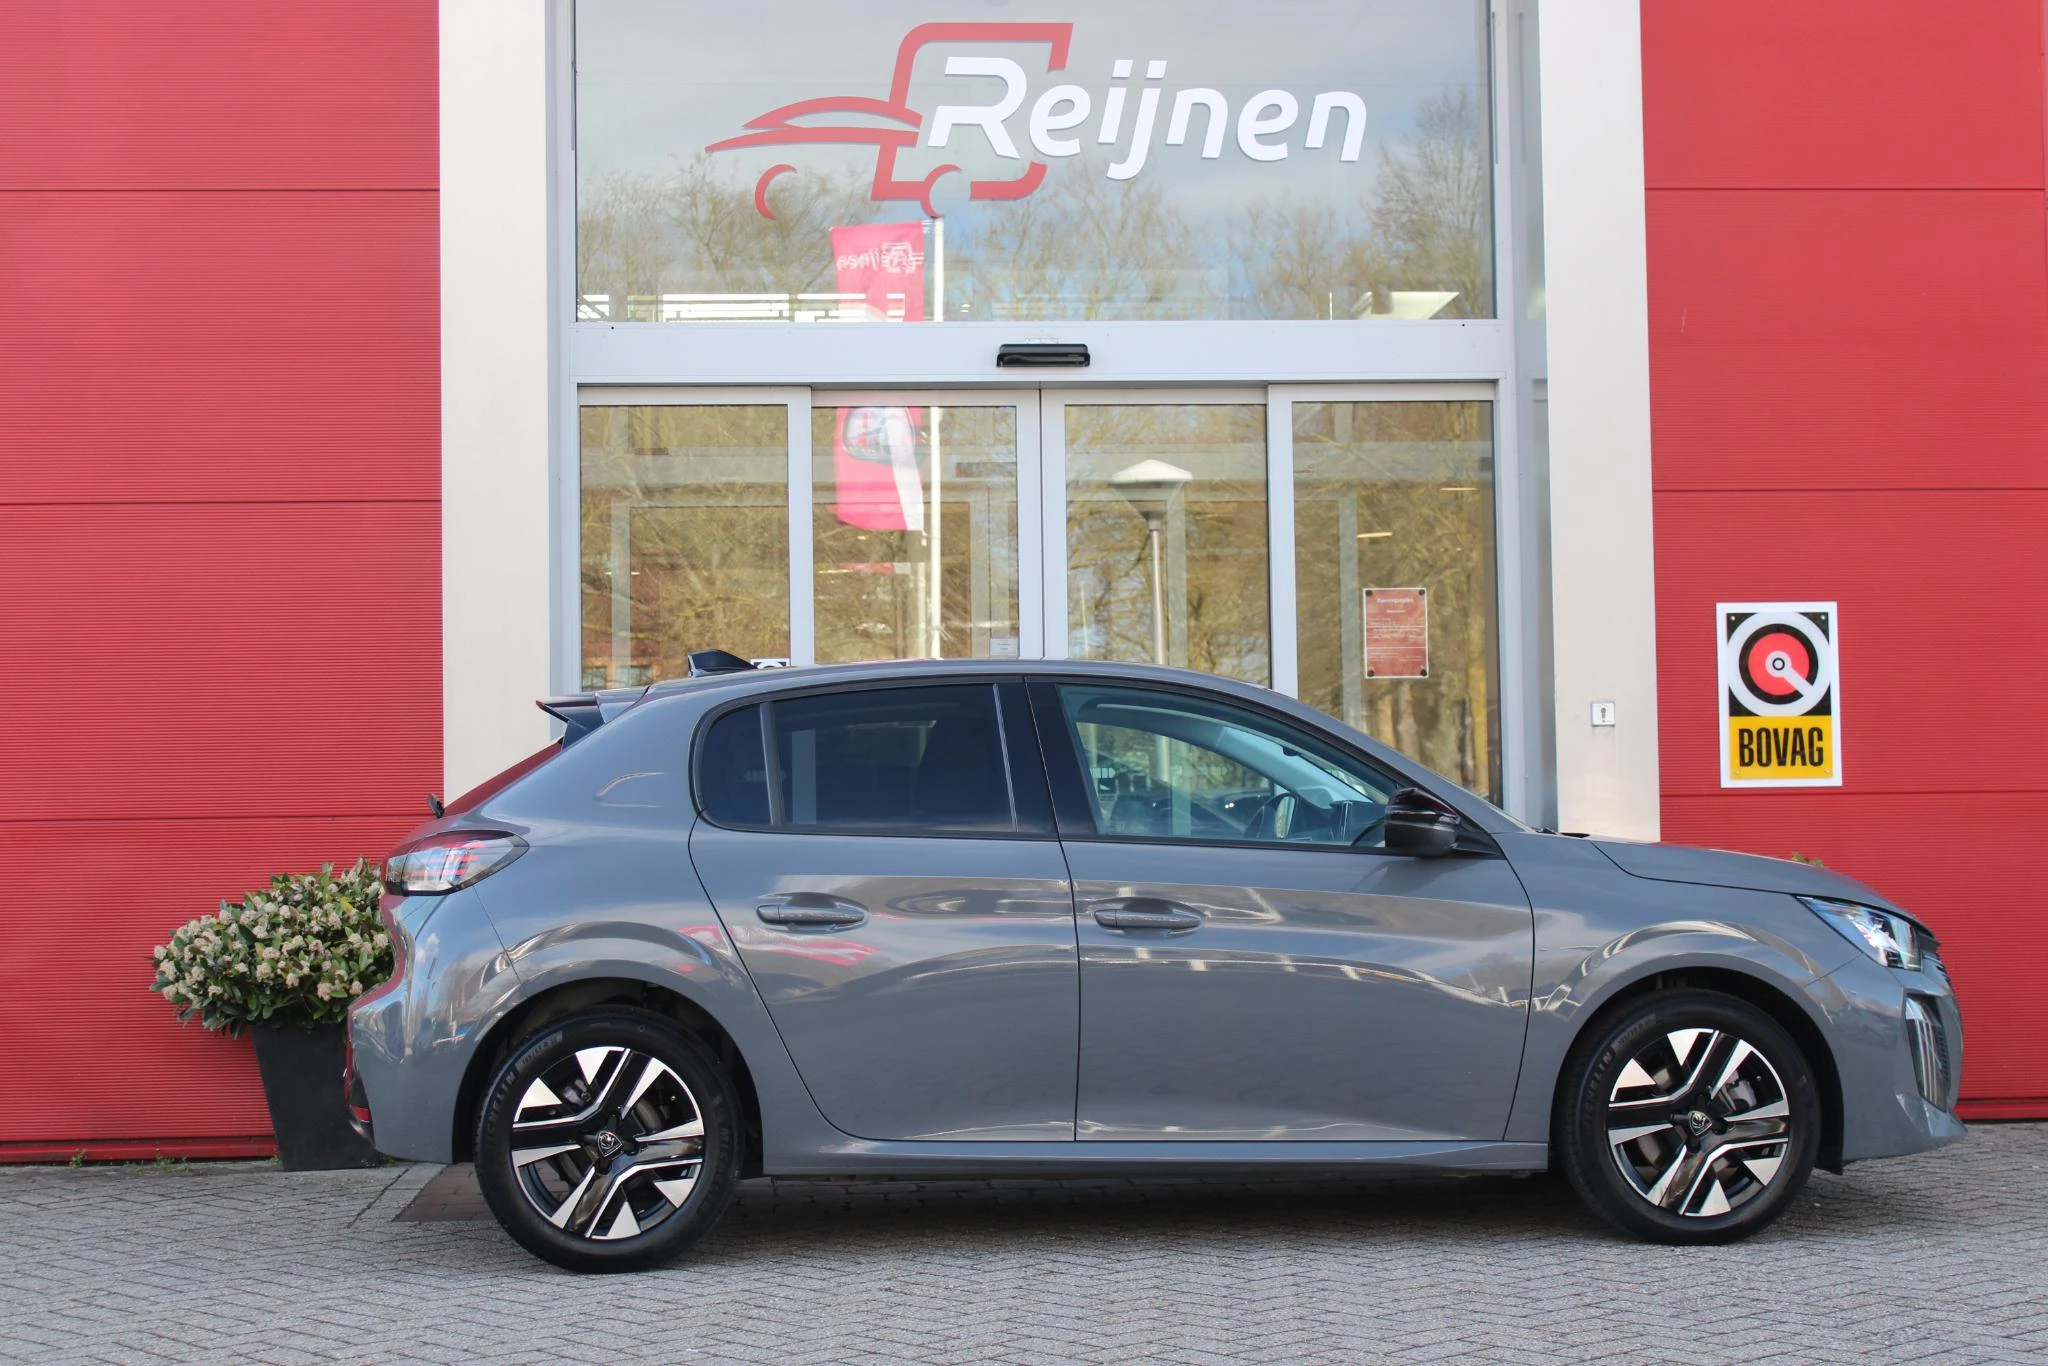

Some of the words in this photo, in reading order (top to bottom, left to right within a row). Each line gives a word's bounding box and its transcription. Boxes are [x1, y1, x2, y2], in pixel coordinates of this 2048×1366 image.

[927, 56, 1367, 180] Reijnen
[1738, 727, 1824, 767] BOVAG
[486, 1071, 516, 1151] ICHELIN
[1583, 1051, 1613, 1134] ICHELIN
